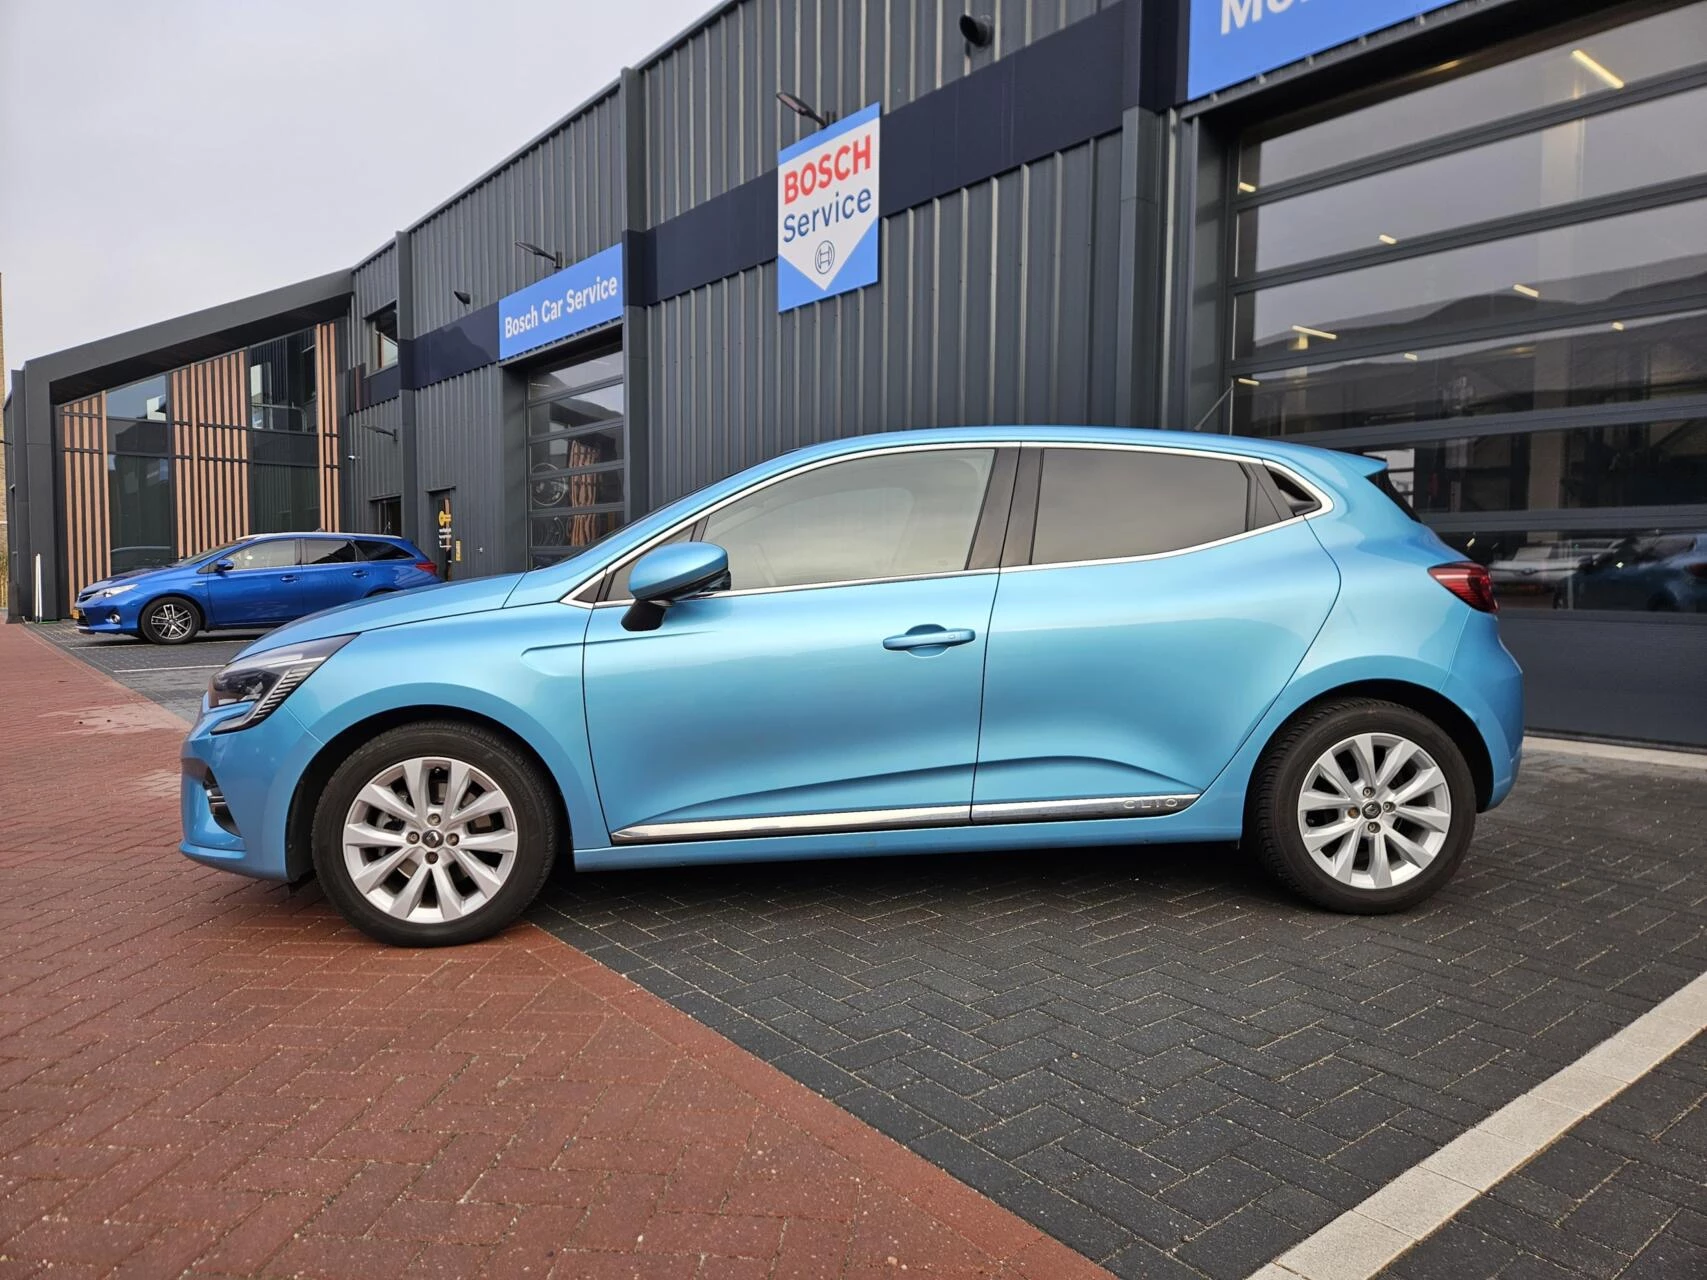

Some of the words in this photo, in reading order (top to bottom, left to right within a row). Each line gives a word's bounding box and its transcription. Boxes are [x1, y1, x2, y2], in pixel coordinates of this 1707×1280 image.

[784, 135, 871, 205] BOSCH
[783, 188, 872, 243] Service
[505, 304, 538, 338] Bosch
[541, 299, 563, 323] Car
[566, 276, 618, 313] Service
[1123, 798, 1178, 809] CLIO
